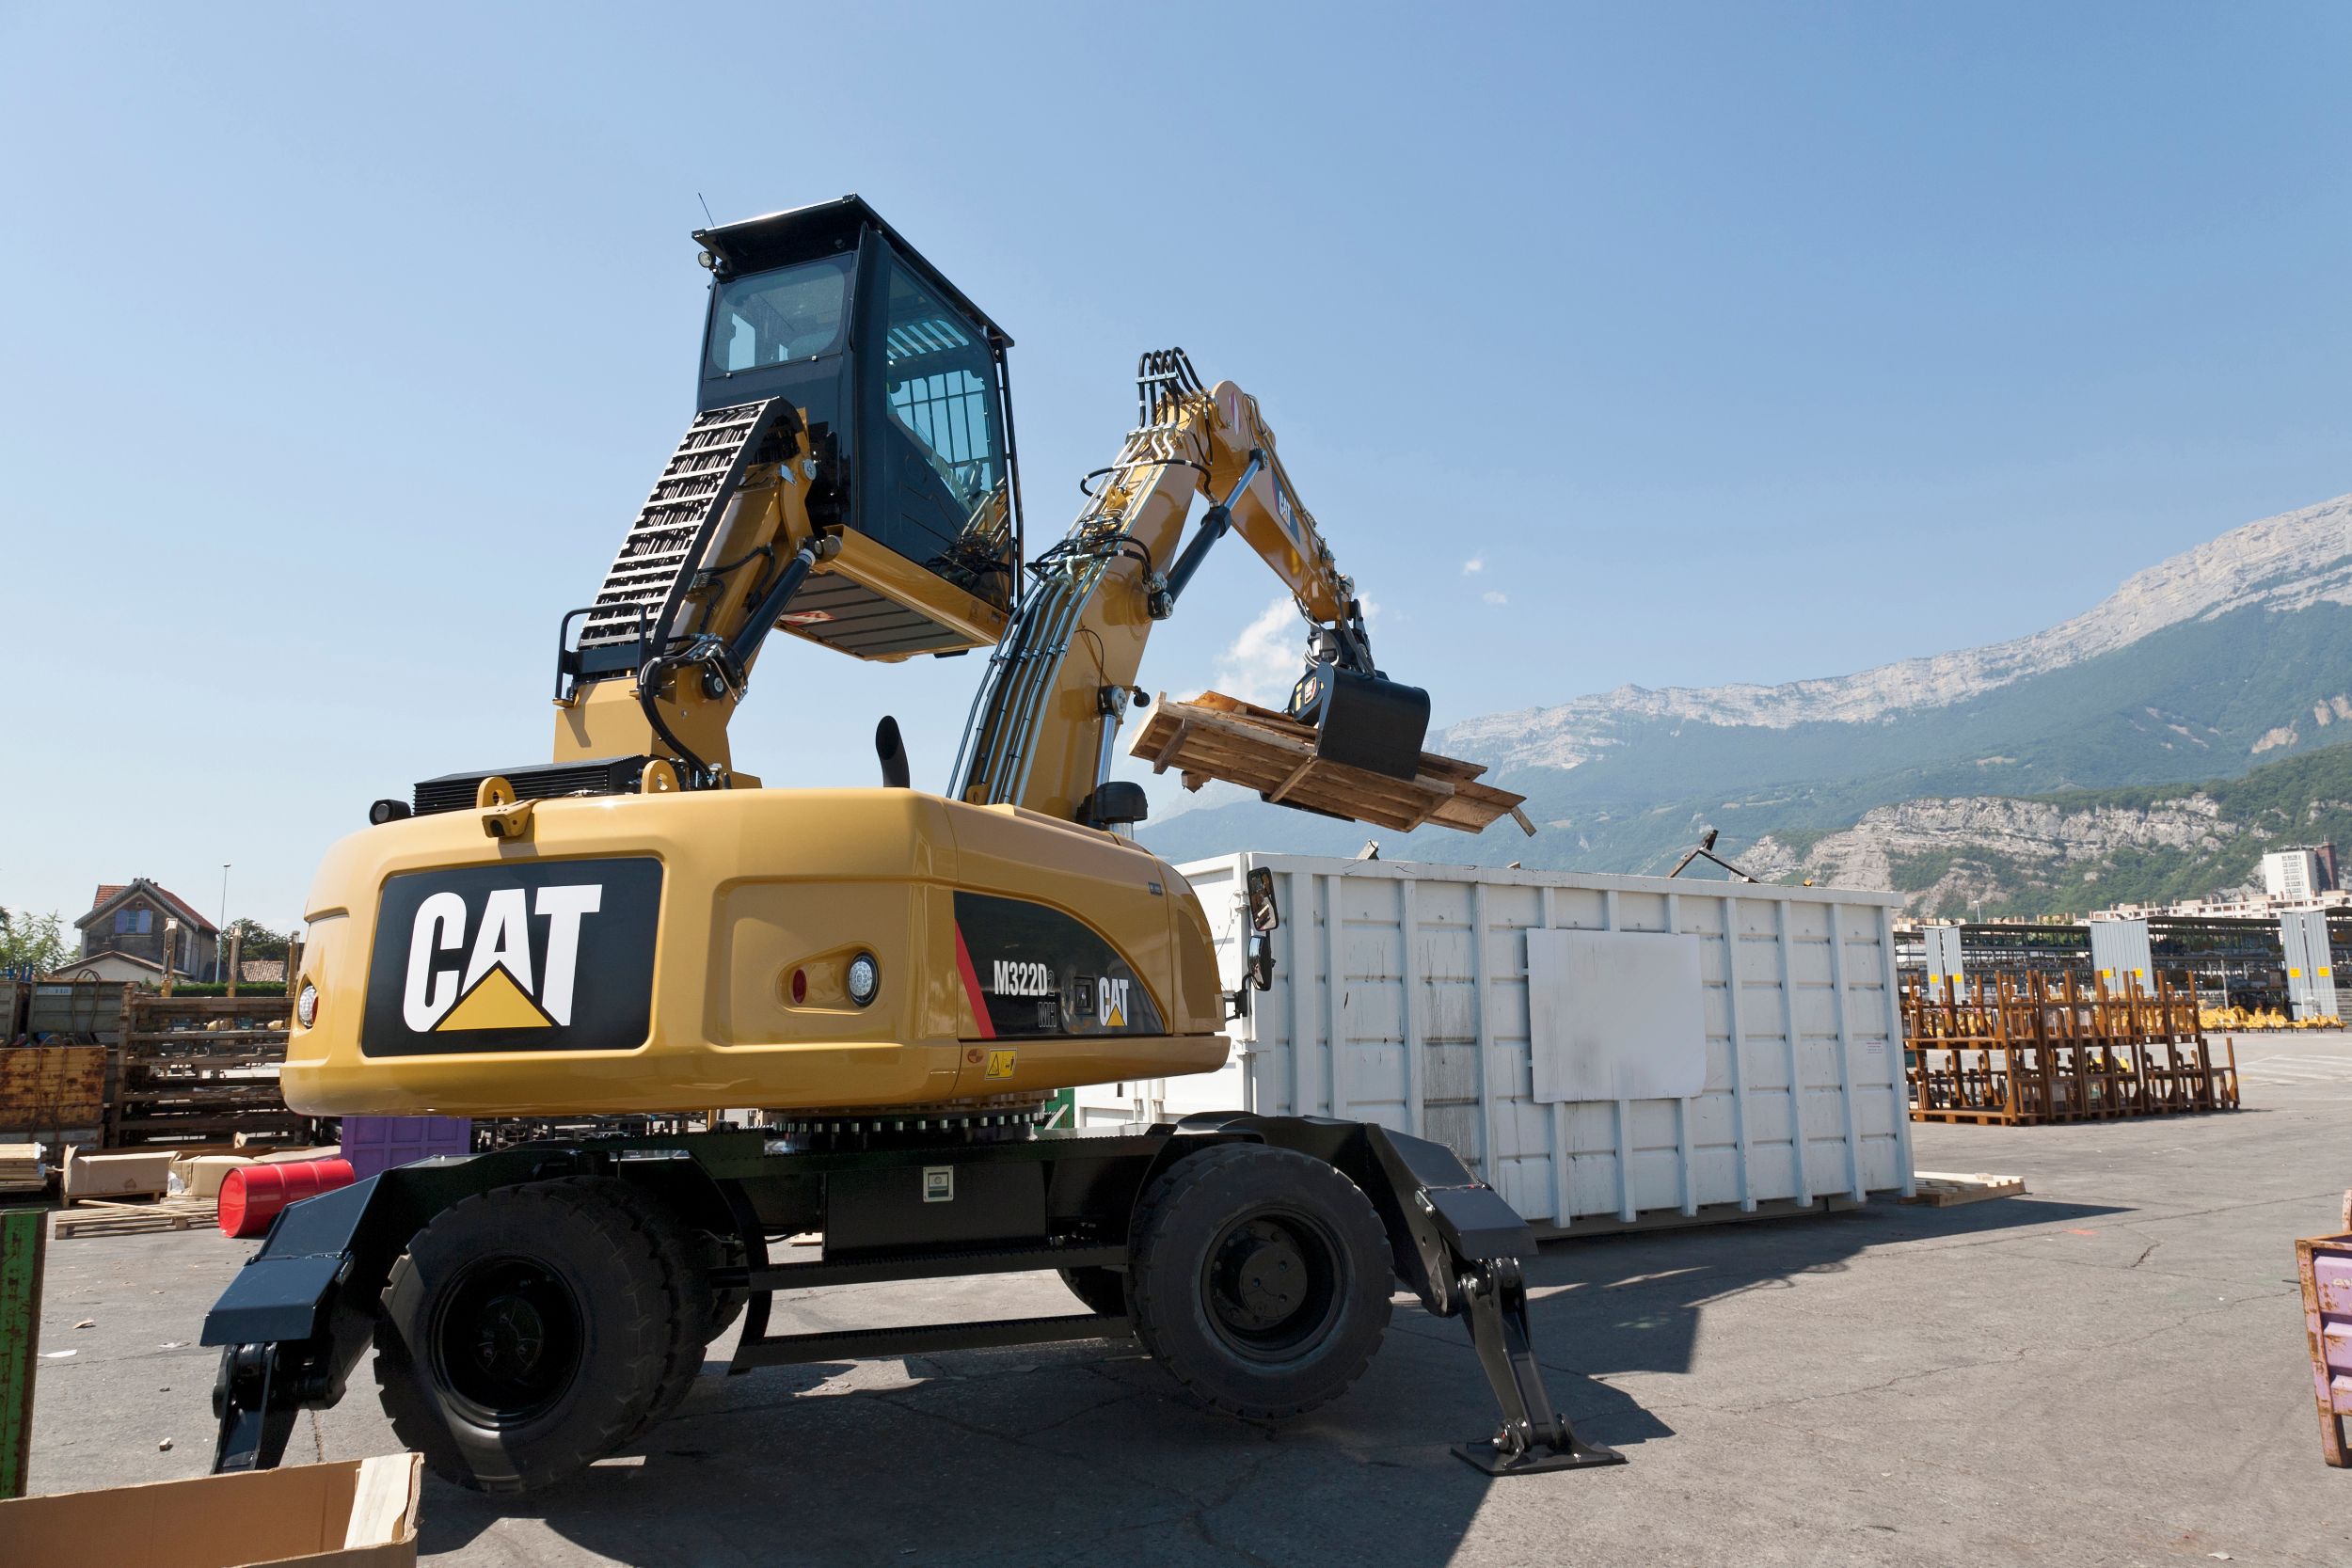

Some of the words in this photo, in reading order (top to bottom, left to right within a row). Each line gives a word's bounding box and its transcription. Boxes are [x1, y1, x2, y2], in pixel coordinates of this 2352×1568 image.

[1279, 490, 1291, 527] CAT
[403, 884, 603, 1032] CAT
[1099, 977, 1129, 1026] CAT
